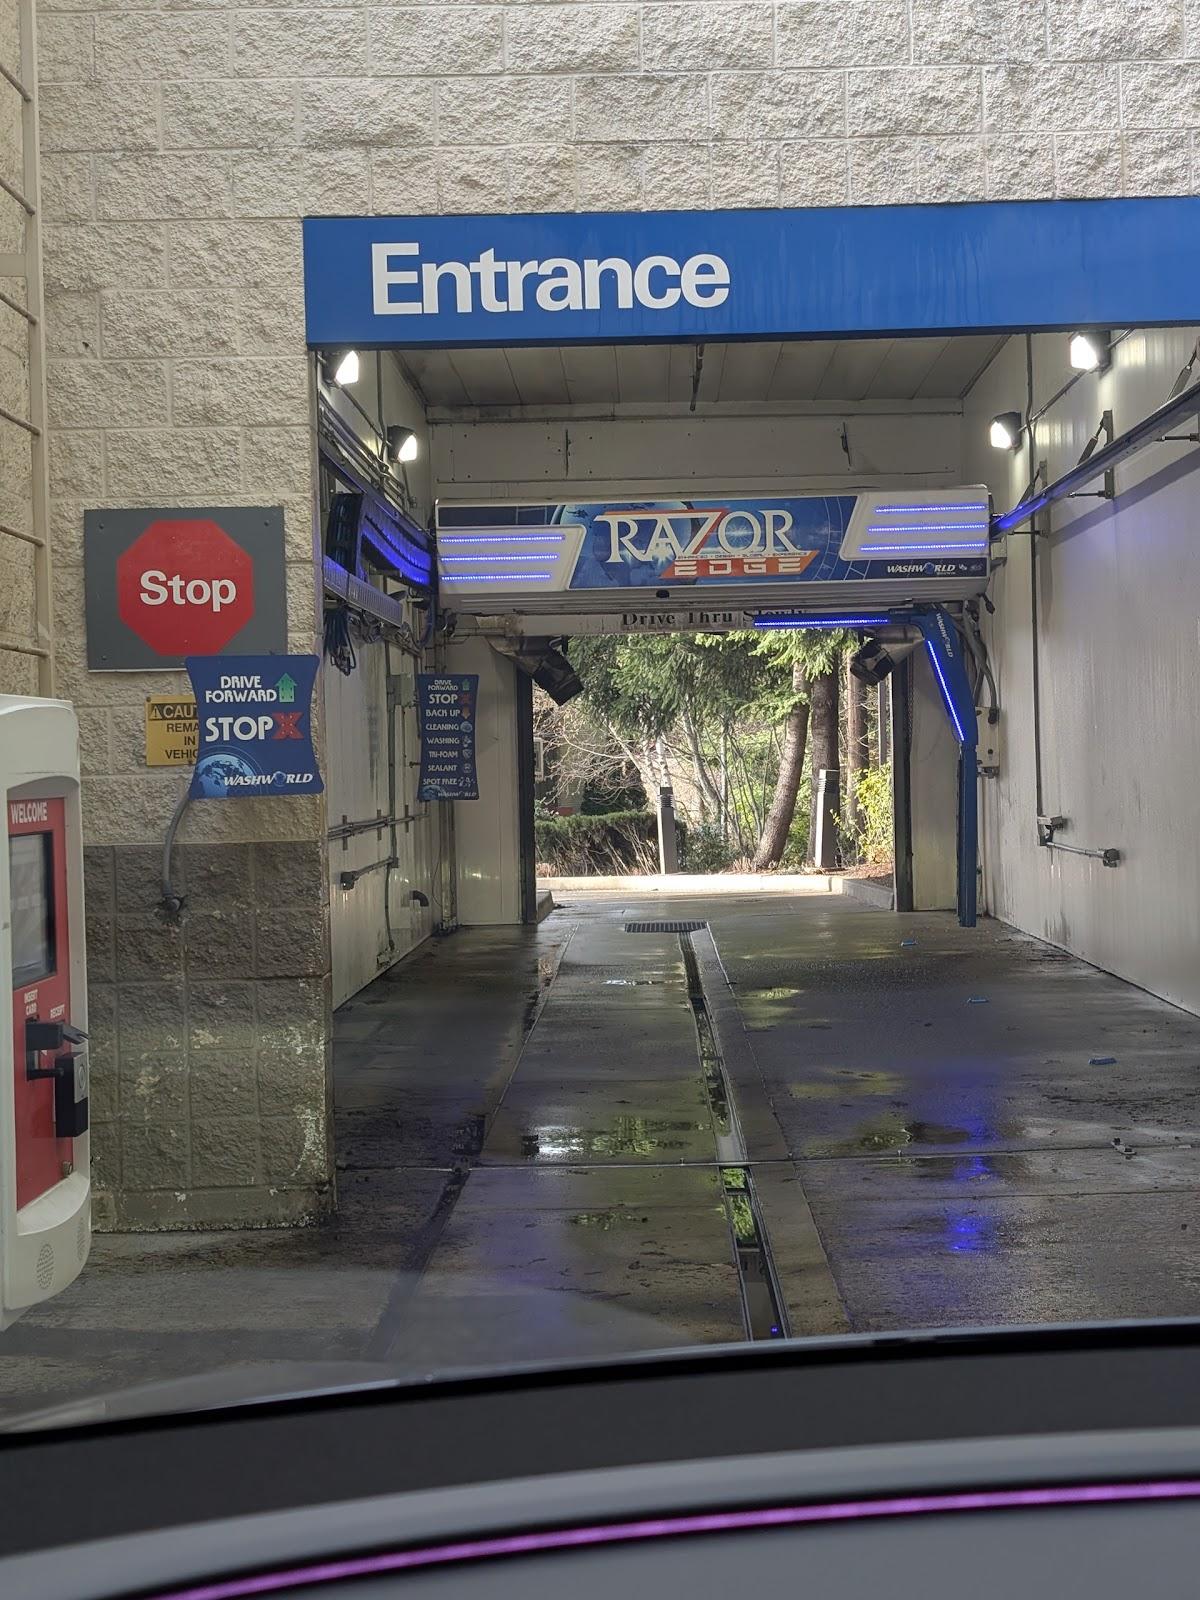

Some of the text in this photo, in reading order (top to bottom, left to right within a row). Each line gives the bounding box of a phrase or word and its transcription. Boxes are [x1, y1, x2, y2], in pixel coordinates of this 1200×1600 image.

[371, 242, 731, 315] Entrance
[593, 509, 814, 563] RAZOR
[674, 557, 801, 576] EDGE
[139, 570, 237, 612] Stop
[622, 612, 676, 626] Drive
[220, 675, 262, 689] DRIVE
[205, 689, 277, 703] FORWARD
[428, 693, 459, 704] STOP
[425, 709, 461, 717] BACK UP
[205, 716, 274, 742] STOP
[425, 723, 460, 731] CLEANING
[184, 735, 196, 746] IN
[426, 737, 461, 745] WASHING
[428, 750, 459, 758] TRI-FOAM
[428, 764, 458, 772] SEALANT
[223, 771, 314, 787] WASHWORLD
[10, 801, 48, 825] WELCOME
